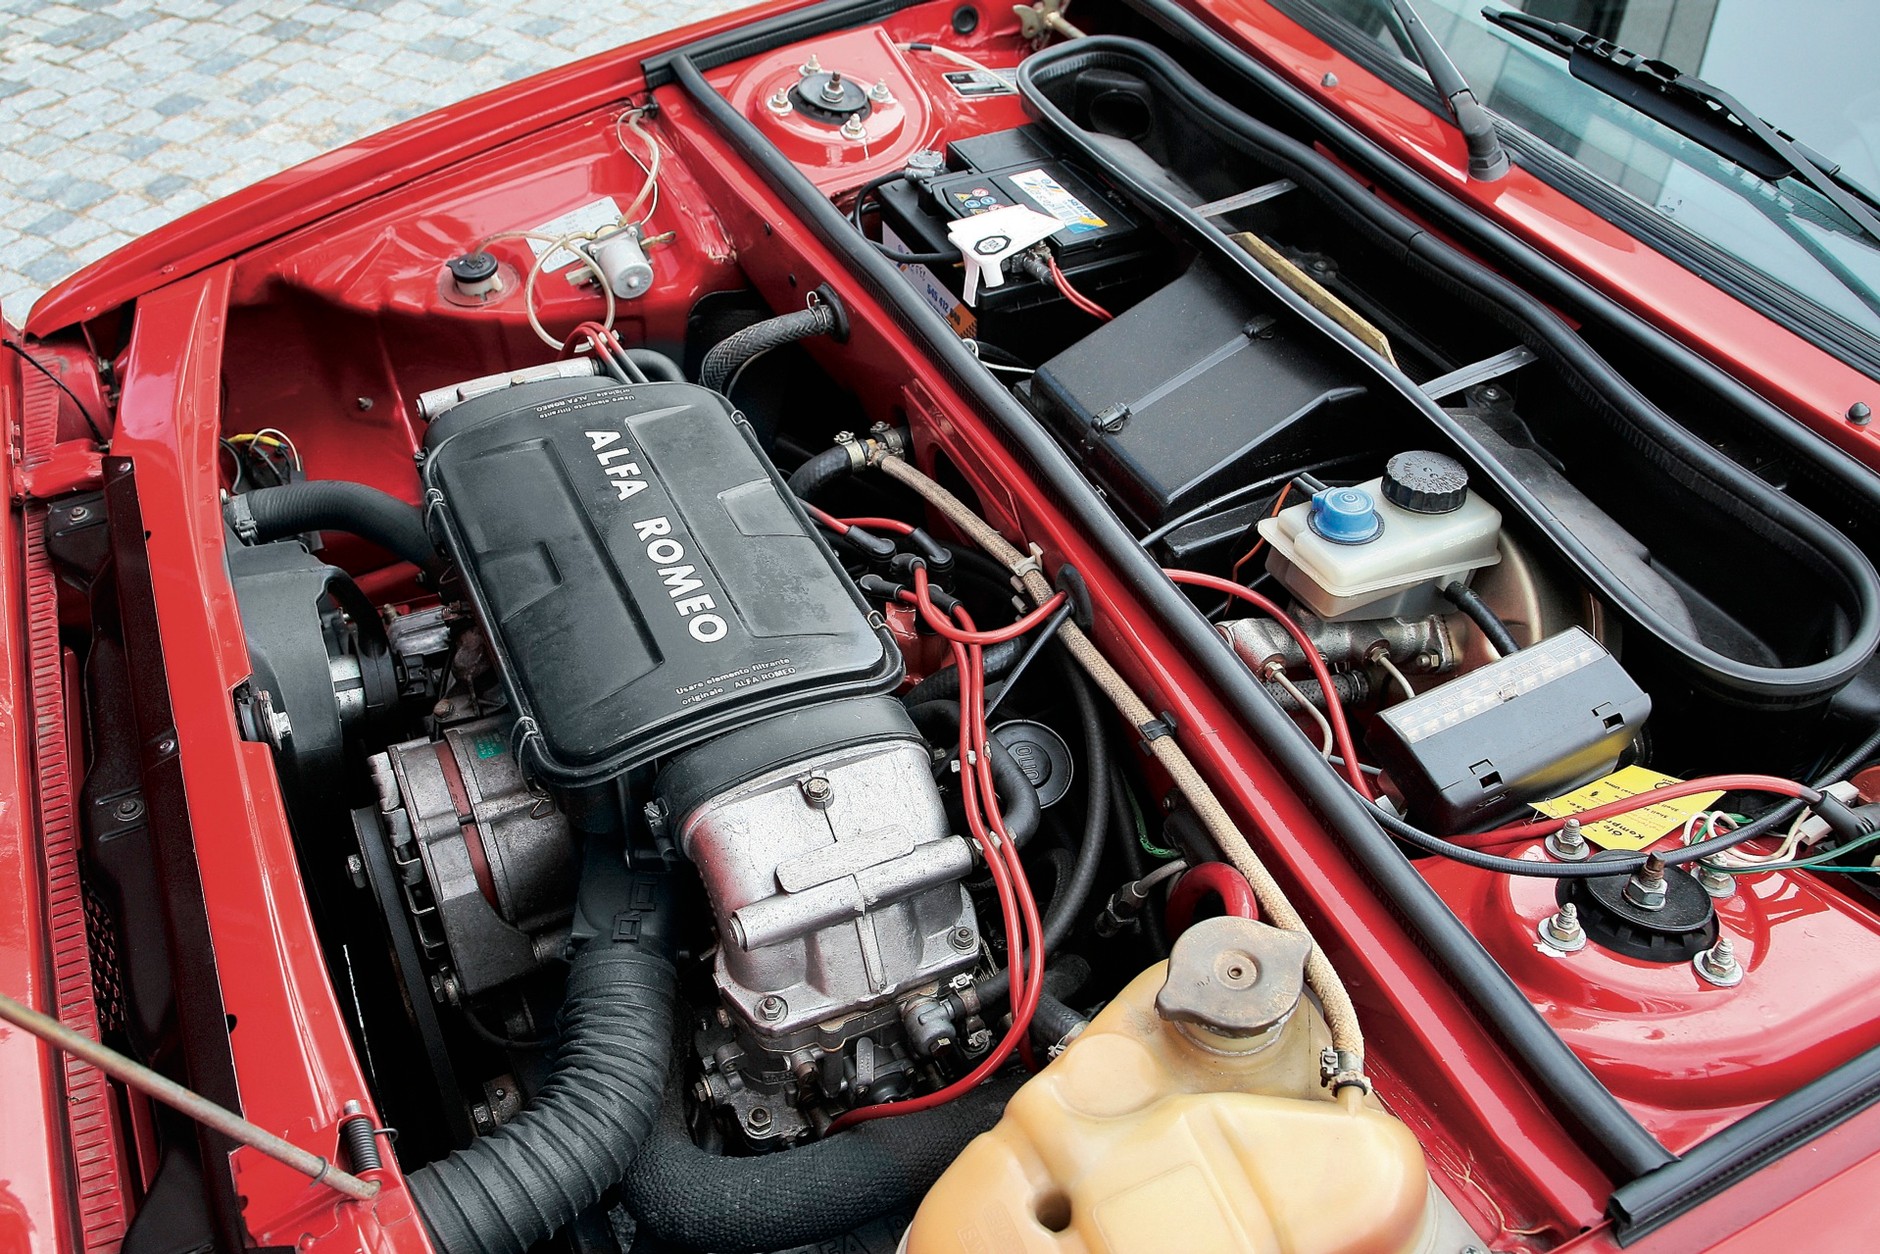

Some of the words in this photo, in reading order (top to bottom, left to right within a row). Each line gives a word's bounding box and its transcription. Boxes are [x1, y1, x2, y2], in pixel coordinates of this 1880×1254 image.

[567, 395, 588, 404] ALFA
[584, 431, 649, 501] ALFA
[632, 516, 728, 643] ROMEO
[675, 682, 704, 695] Usare
[706, 668, 750, 685] elemento
[751, 658, 790, 672] filtrante
[681, 687, 724, 705] originale
[734, 676, 760, 688] ALFA
[761, 667, 796, 681] ROMEO
